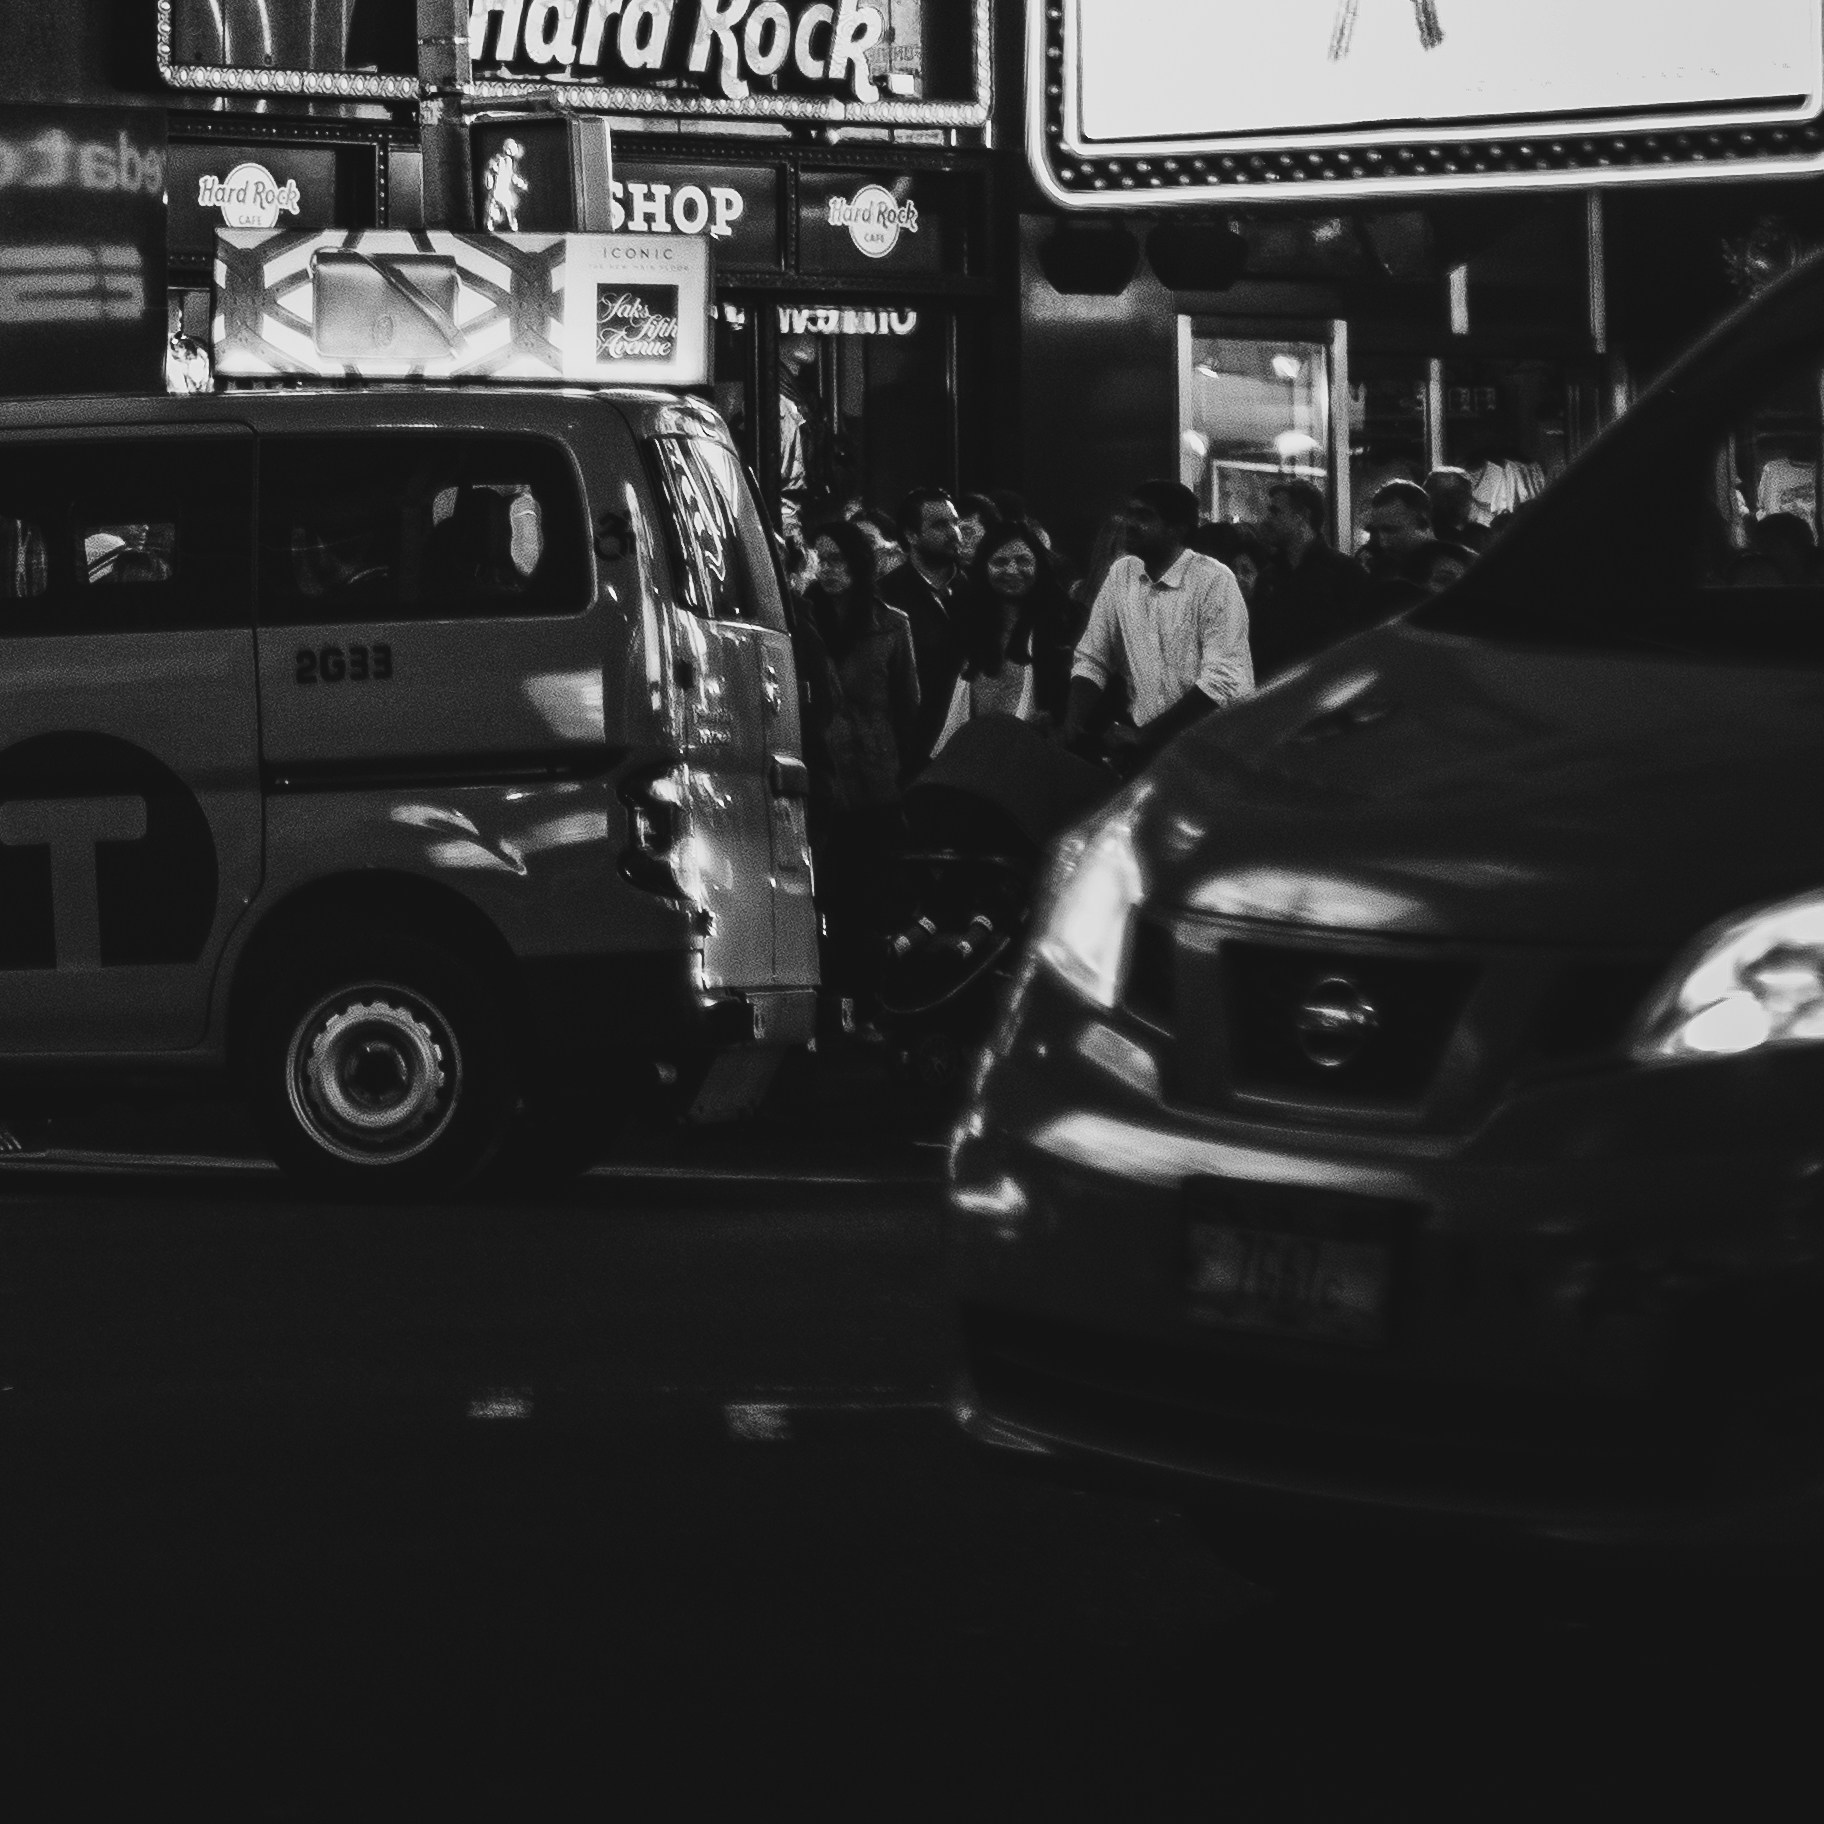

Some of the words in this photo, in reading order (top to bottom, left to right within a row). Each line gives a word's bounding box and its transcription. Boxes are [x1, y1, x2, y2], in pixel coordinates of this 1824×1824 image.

[197, 173, 248, 215] Hard
[247, 178, 301, 218] Rock
[828, 194, 873, 229] Hard
[873, 197, 920, 235] Rock
[602, 246, 675, 261] ICONIC
[863, 232, 887, 244] CAFE
[597, 292, 650, 327] Saks
[596, 327, 672, 359] Avenue
[623, 314, 678, 342] Fifth
[295, 644, 394, 684] 2G33
